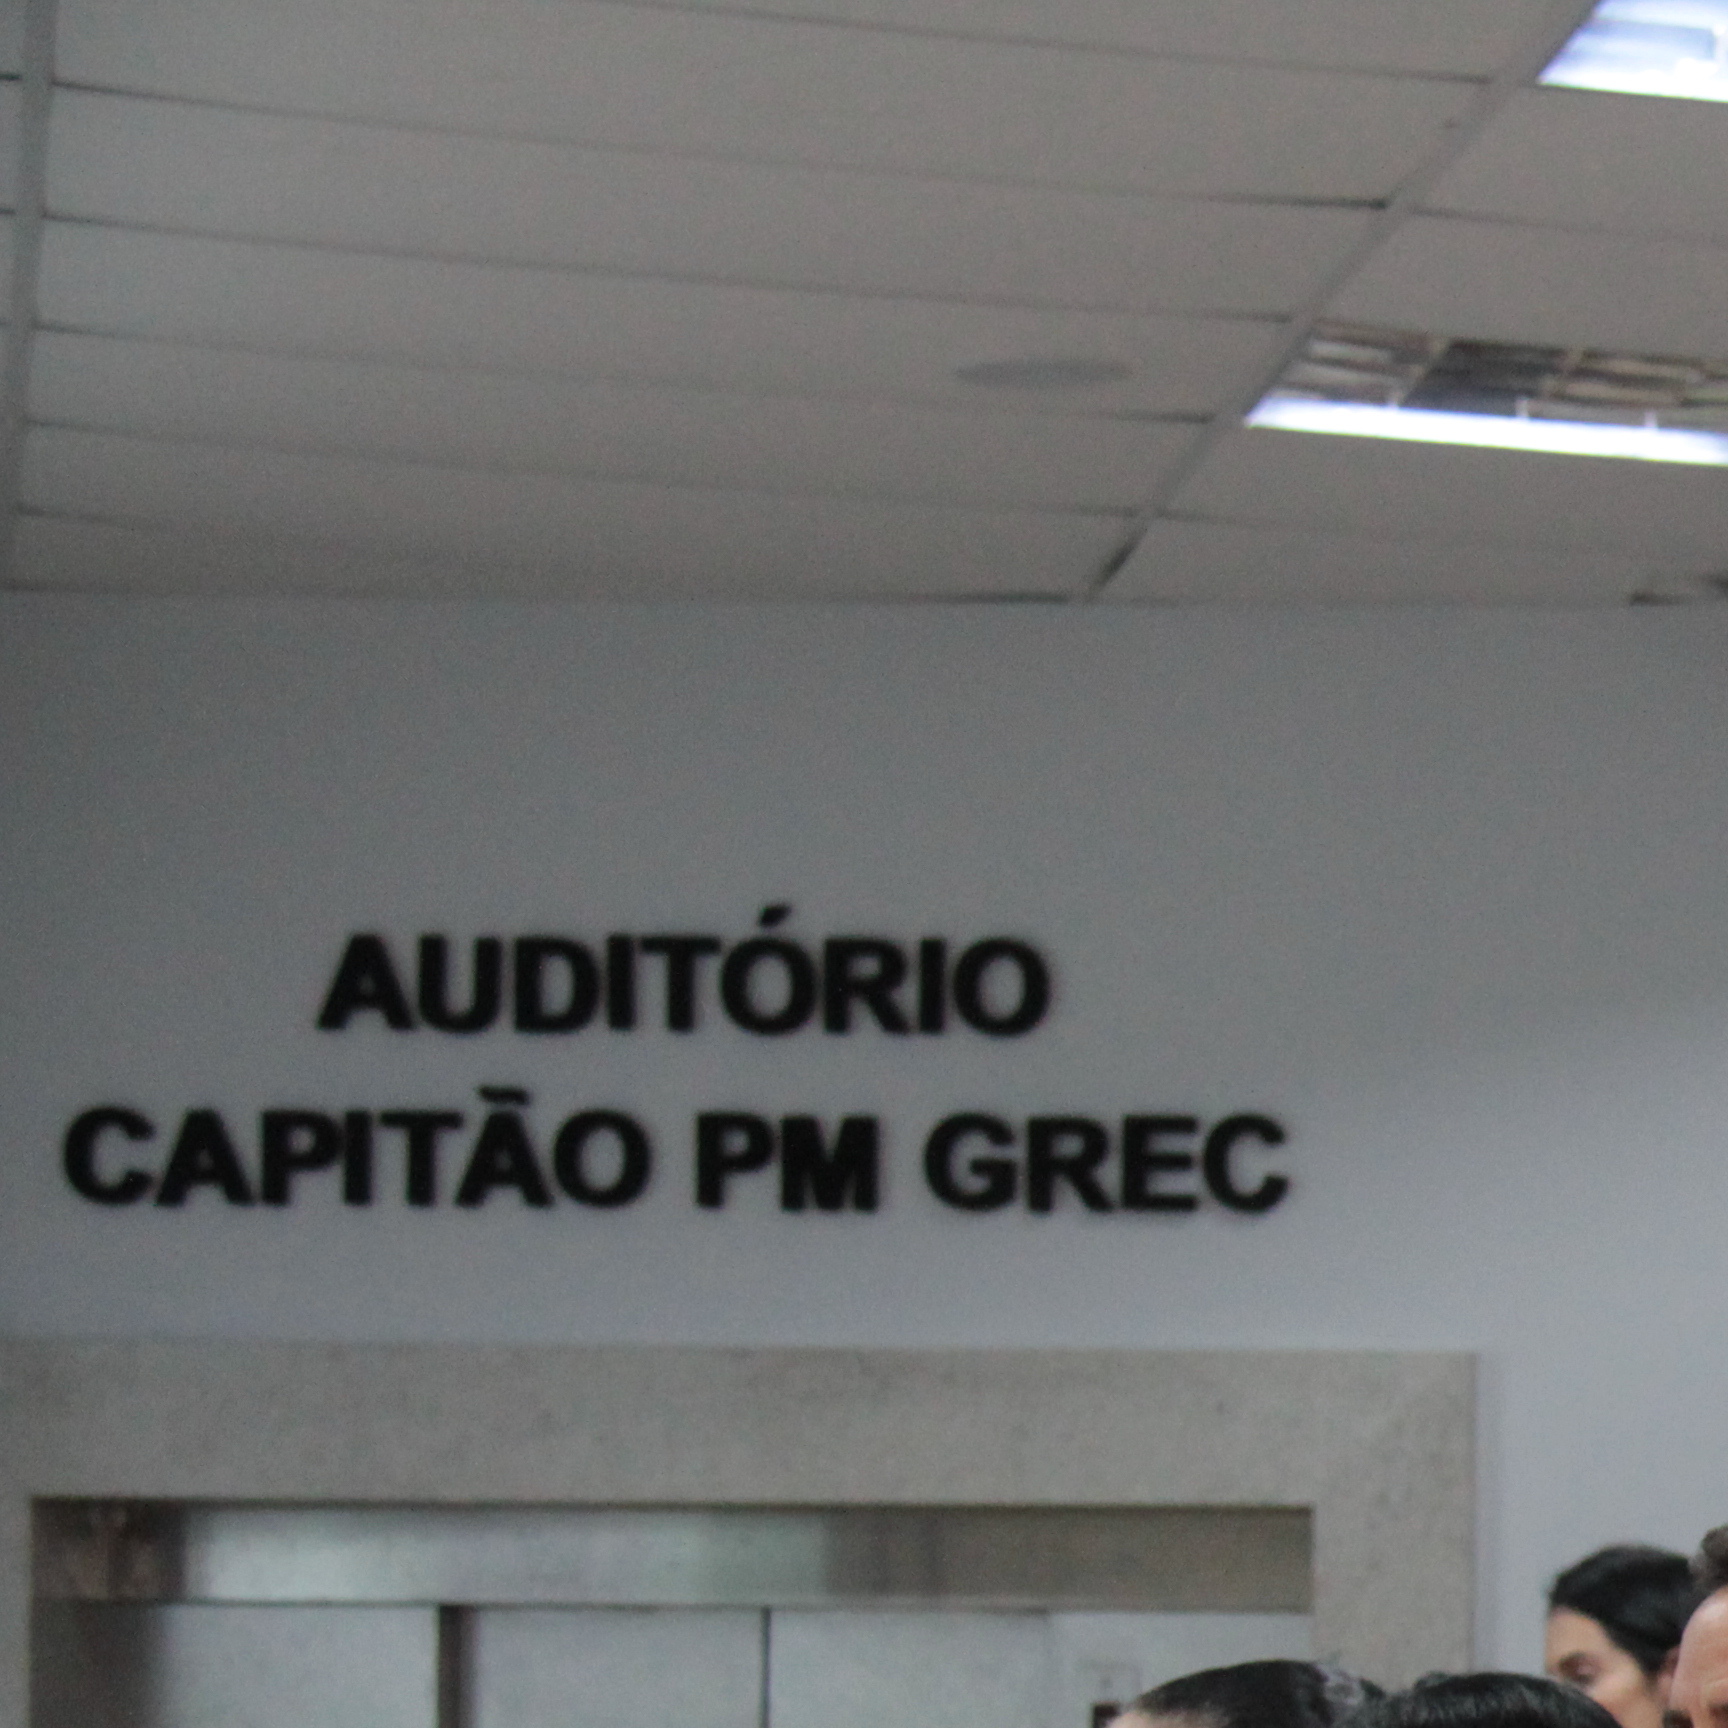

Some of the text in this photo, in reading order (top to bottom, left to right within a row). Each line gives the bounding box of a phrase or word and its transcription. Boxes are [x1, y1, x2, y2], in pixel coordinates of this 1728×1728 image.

[315, 902, 1053, 1039] AUDITÓRIO
[60, 1084, 1288, 1215] CAPITÃO PM GREC
